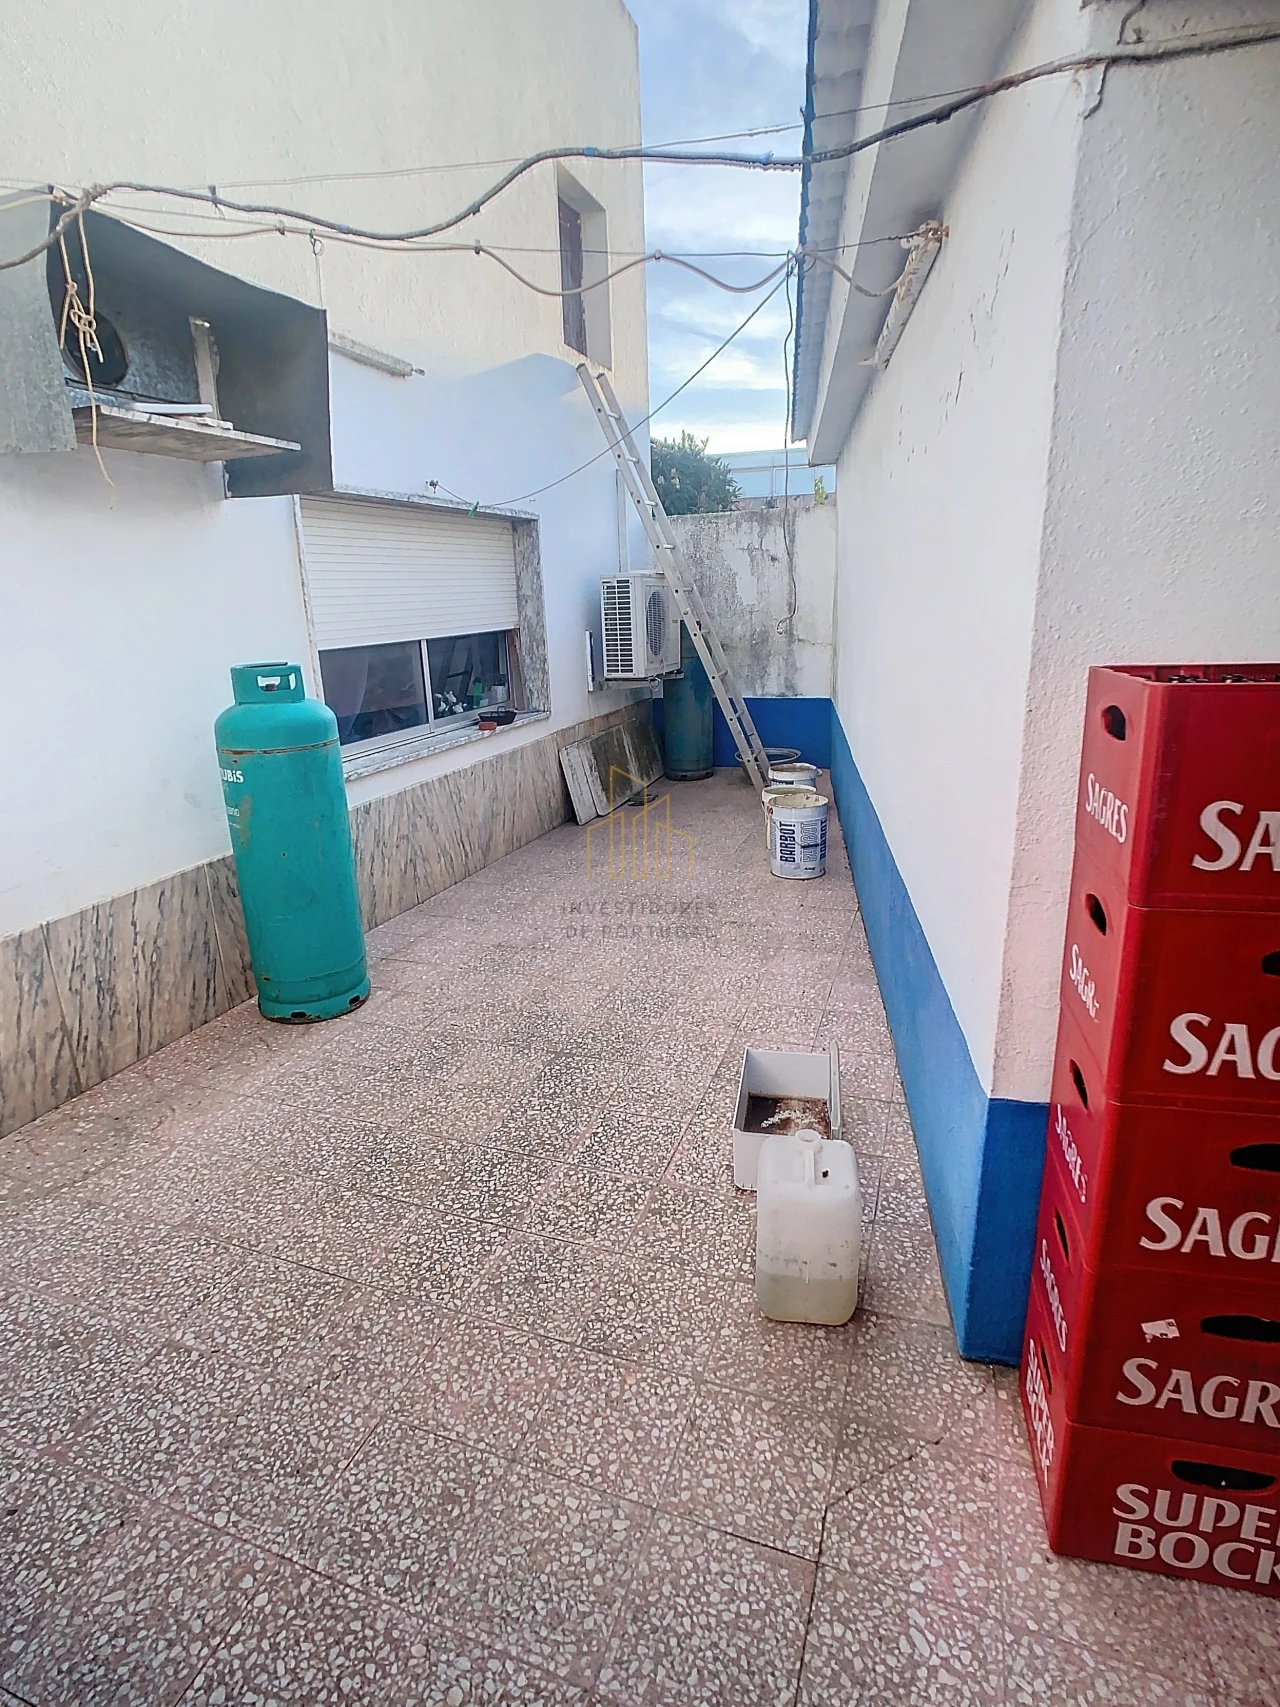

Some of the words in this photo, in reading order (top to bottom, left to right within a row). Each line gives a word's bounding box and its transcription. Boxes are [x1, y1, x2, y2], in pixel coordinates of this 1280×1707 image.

[220, 768, 244, 783] UBiS
[1085, 772, 1129, 844] SAGRES
[779, 821, 796, 863] BARBOT
[1069, 943, 1100, 1023] SAGR
[1139, 1197, 1280, 1263] SAG
[1116, 1357, 1280, 1428] SAGR
[1112, 1483, 1280, 1547] SUPE
